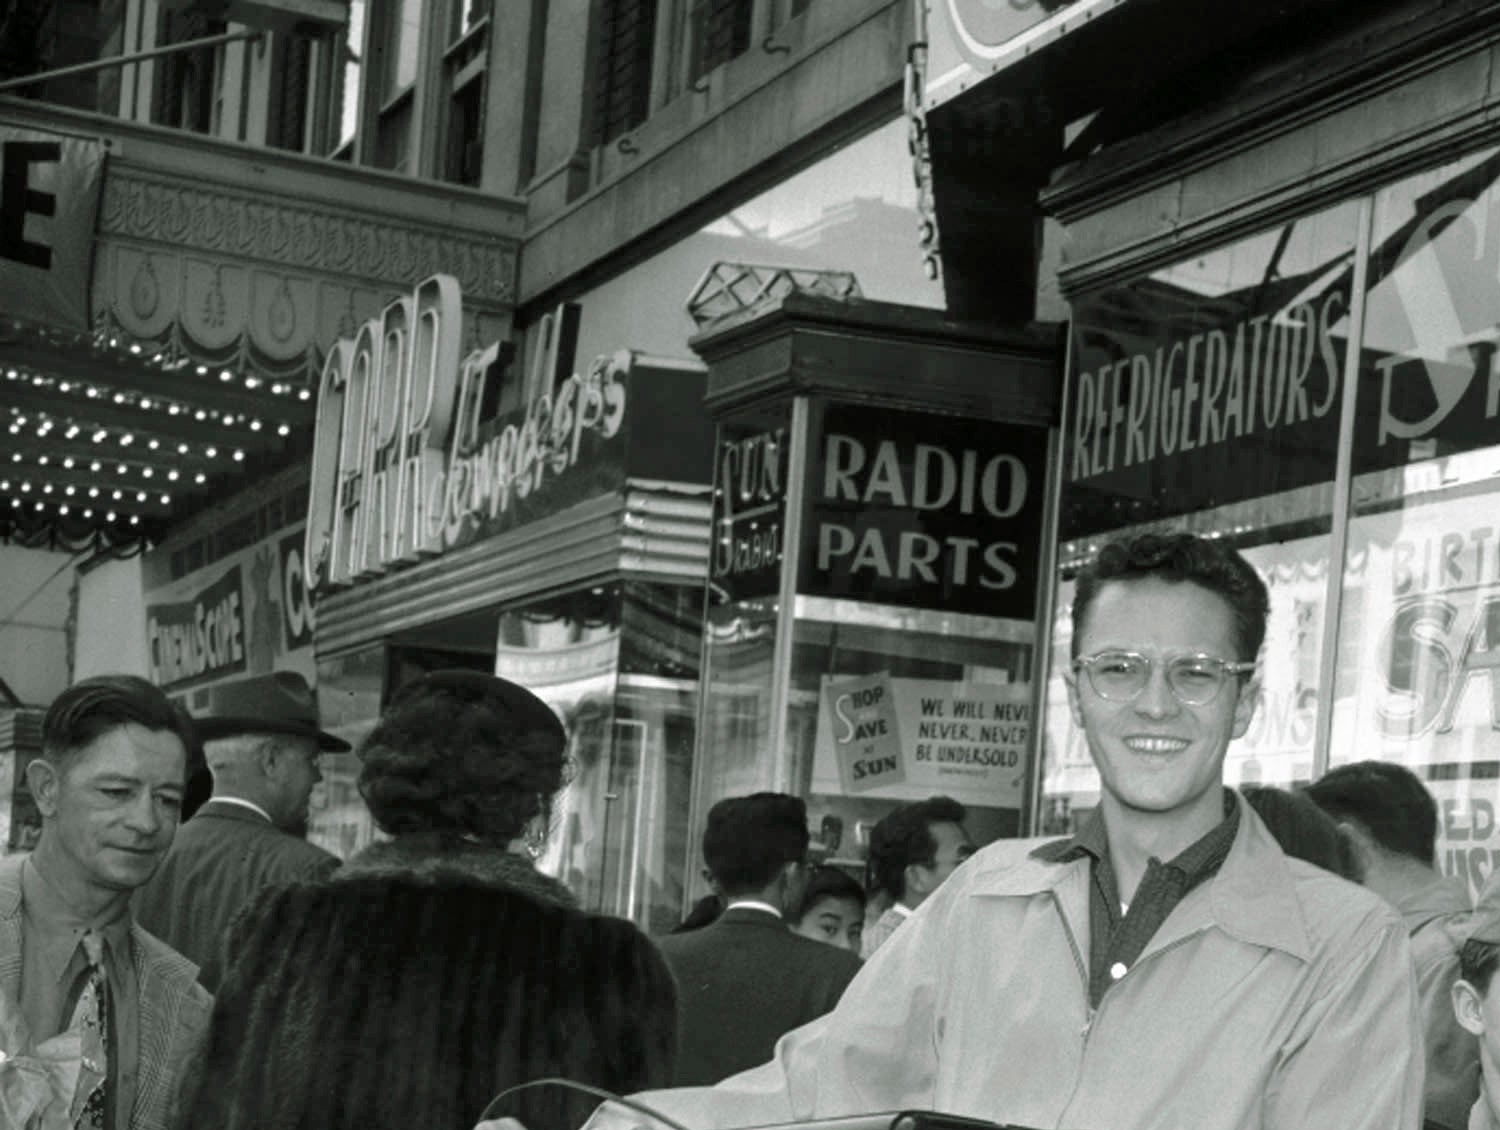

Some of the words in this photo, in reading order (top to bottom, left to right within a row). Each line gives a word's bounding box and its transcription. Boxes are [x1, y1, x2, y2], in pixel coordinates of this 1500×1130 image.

[1072, 290, 1349, 482] REFRIGERATORS
[824, 433, 1029, 519] RADIO
[816, 523, 1019, 592] PARTS
[921, 697, 945, 718] WE
[952, 700, 985, 720] WILL
[853, 755, 897, 781] SUN
[916, 743, 933, 762] BE
[937, 746, 1018, 769] UNDERSOLD
[1434, 798, 1496, 842] ED
